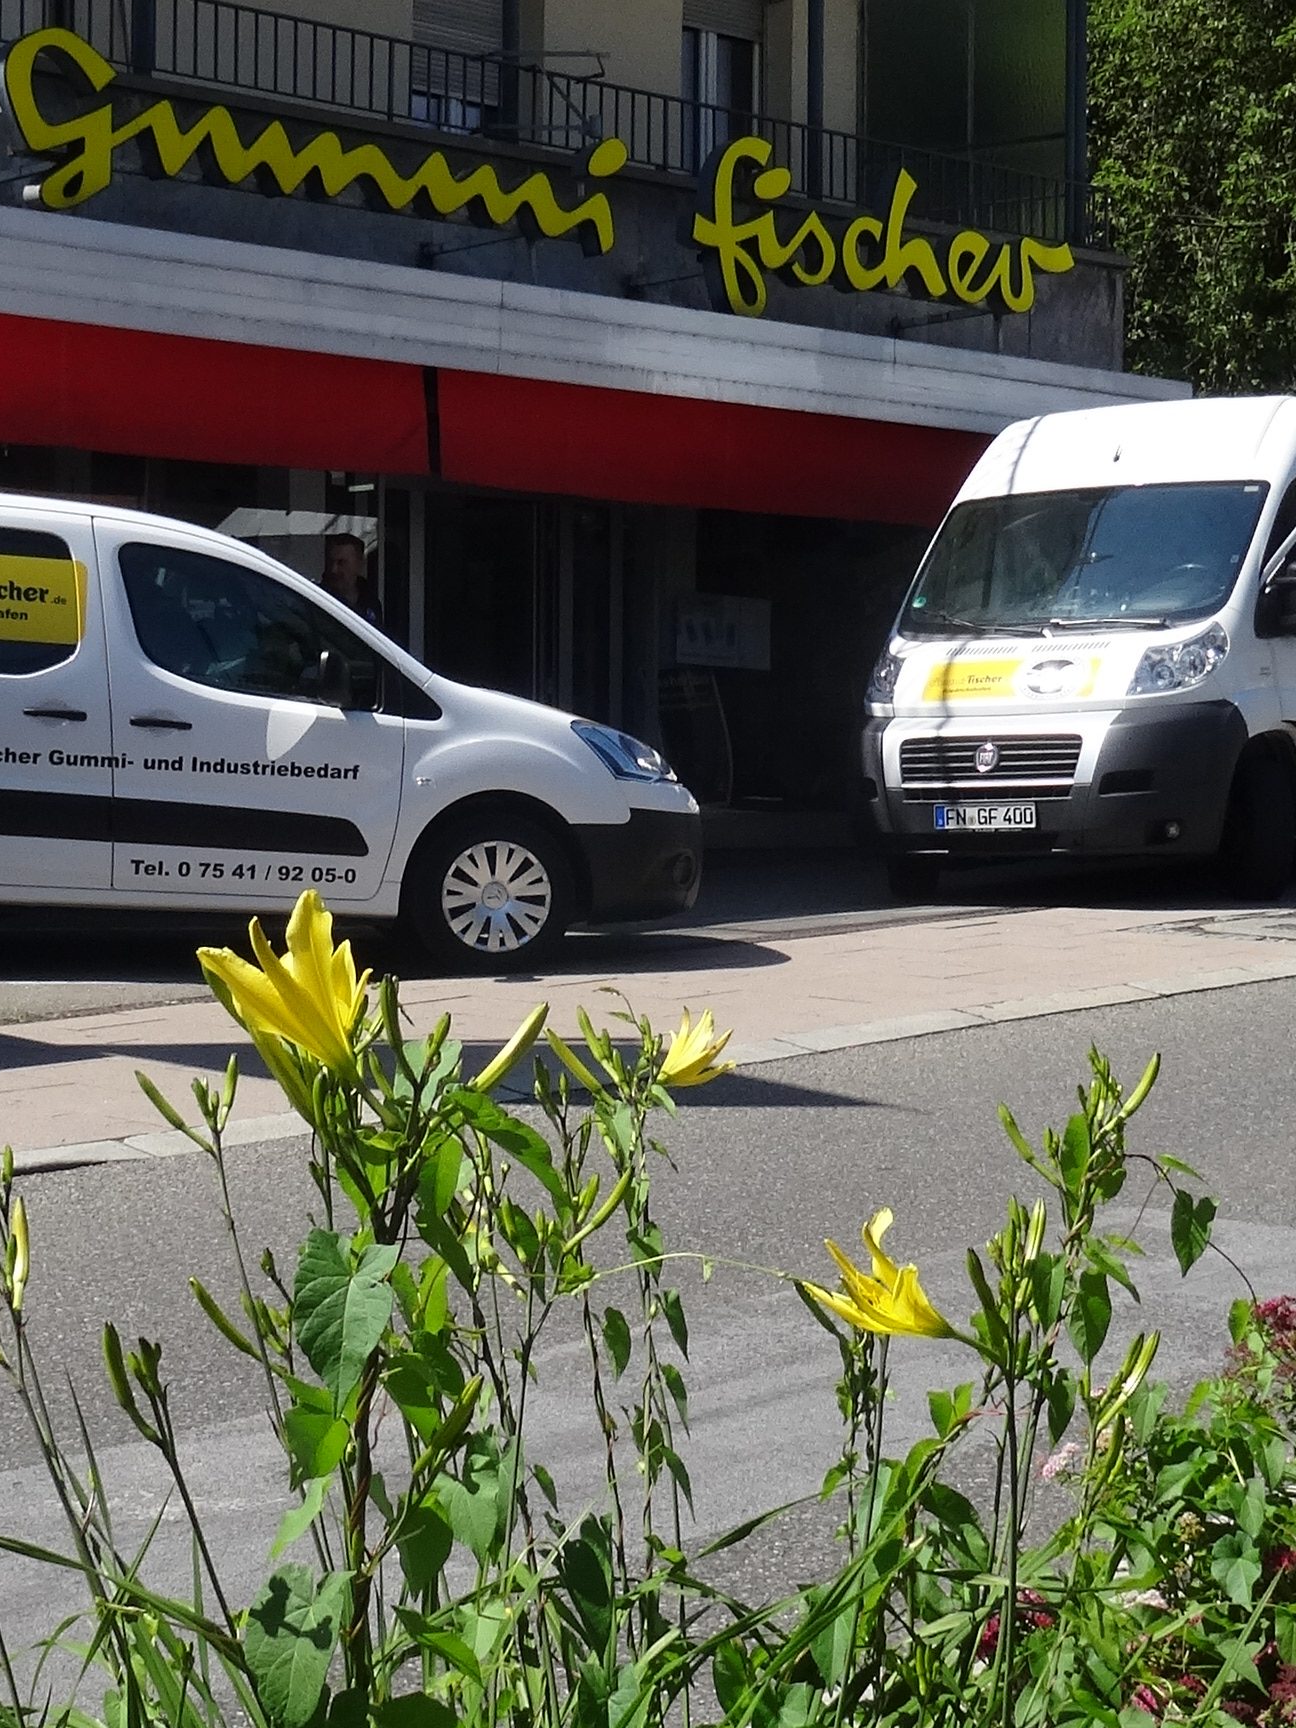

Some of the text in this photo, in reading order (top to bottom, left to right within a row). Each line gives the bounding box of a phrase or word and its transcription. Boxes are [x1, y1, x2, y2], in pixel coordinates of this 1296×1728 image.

[48, 749, 134, 770] Gummi-
[143, 755, 184, 772] und
[191, 756, 360, 780] Industriebedarf
[946, 807, 1034, 826] FN GF 400
[130, 859, 170, 877] Tel.
[177, 861, 191, 877] 0
[197, 862, 225, 879] 75
[231, 862, 256, 880] 41
[277, 864, 305, 882] 92
[310, 866, 357, 884] 05-0
